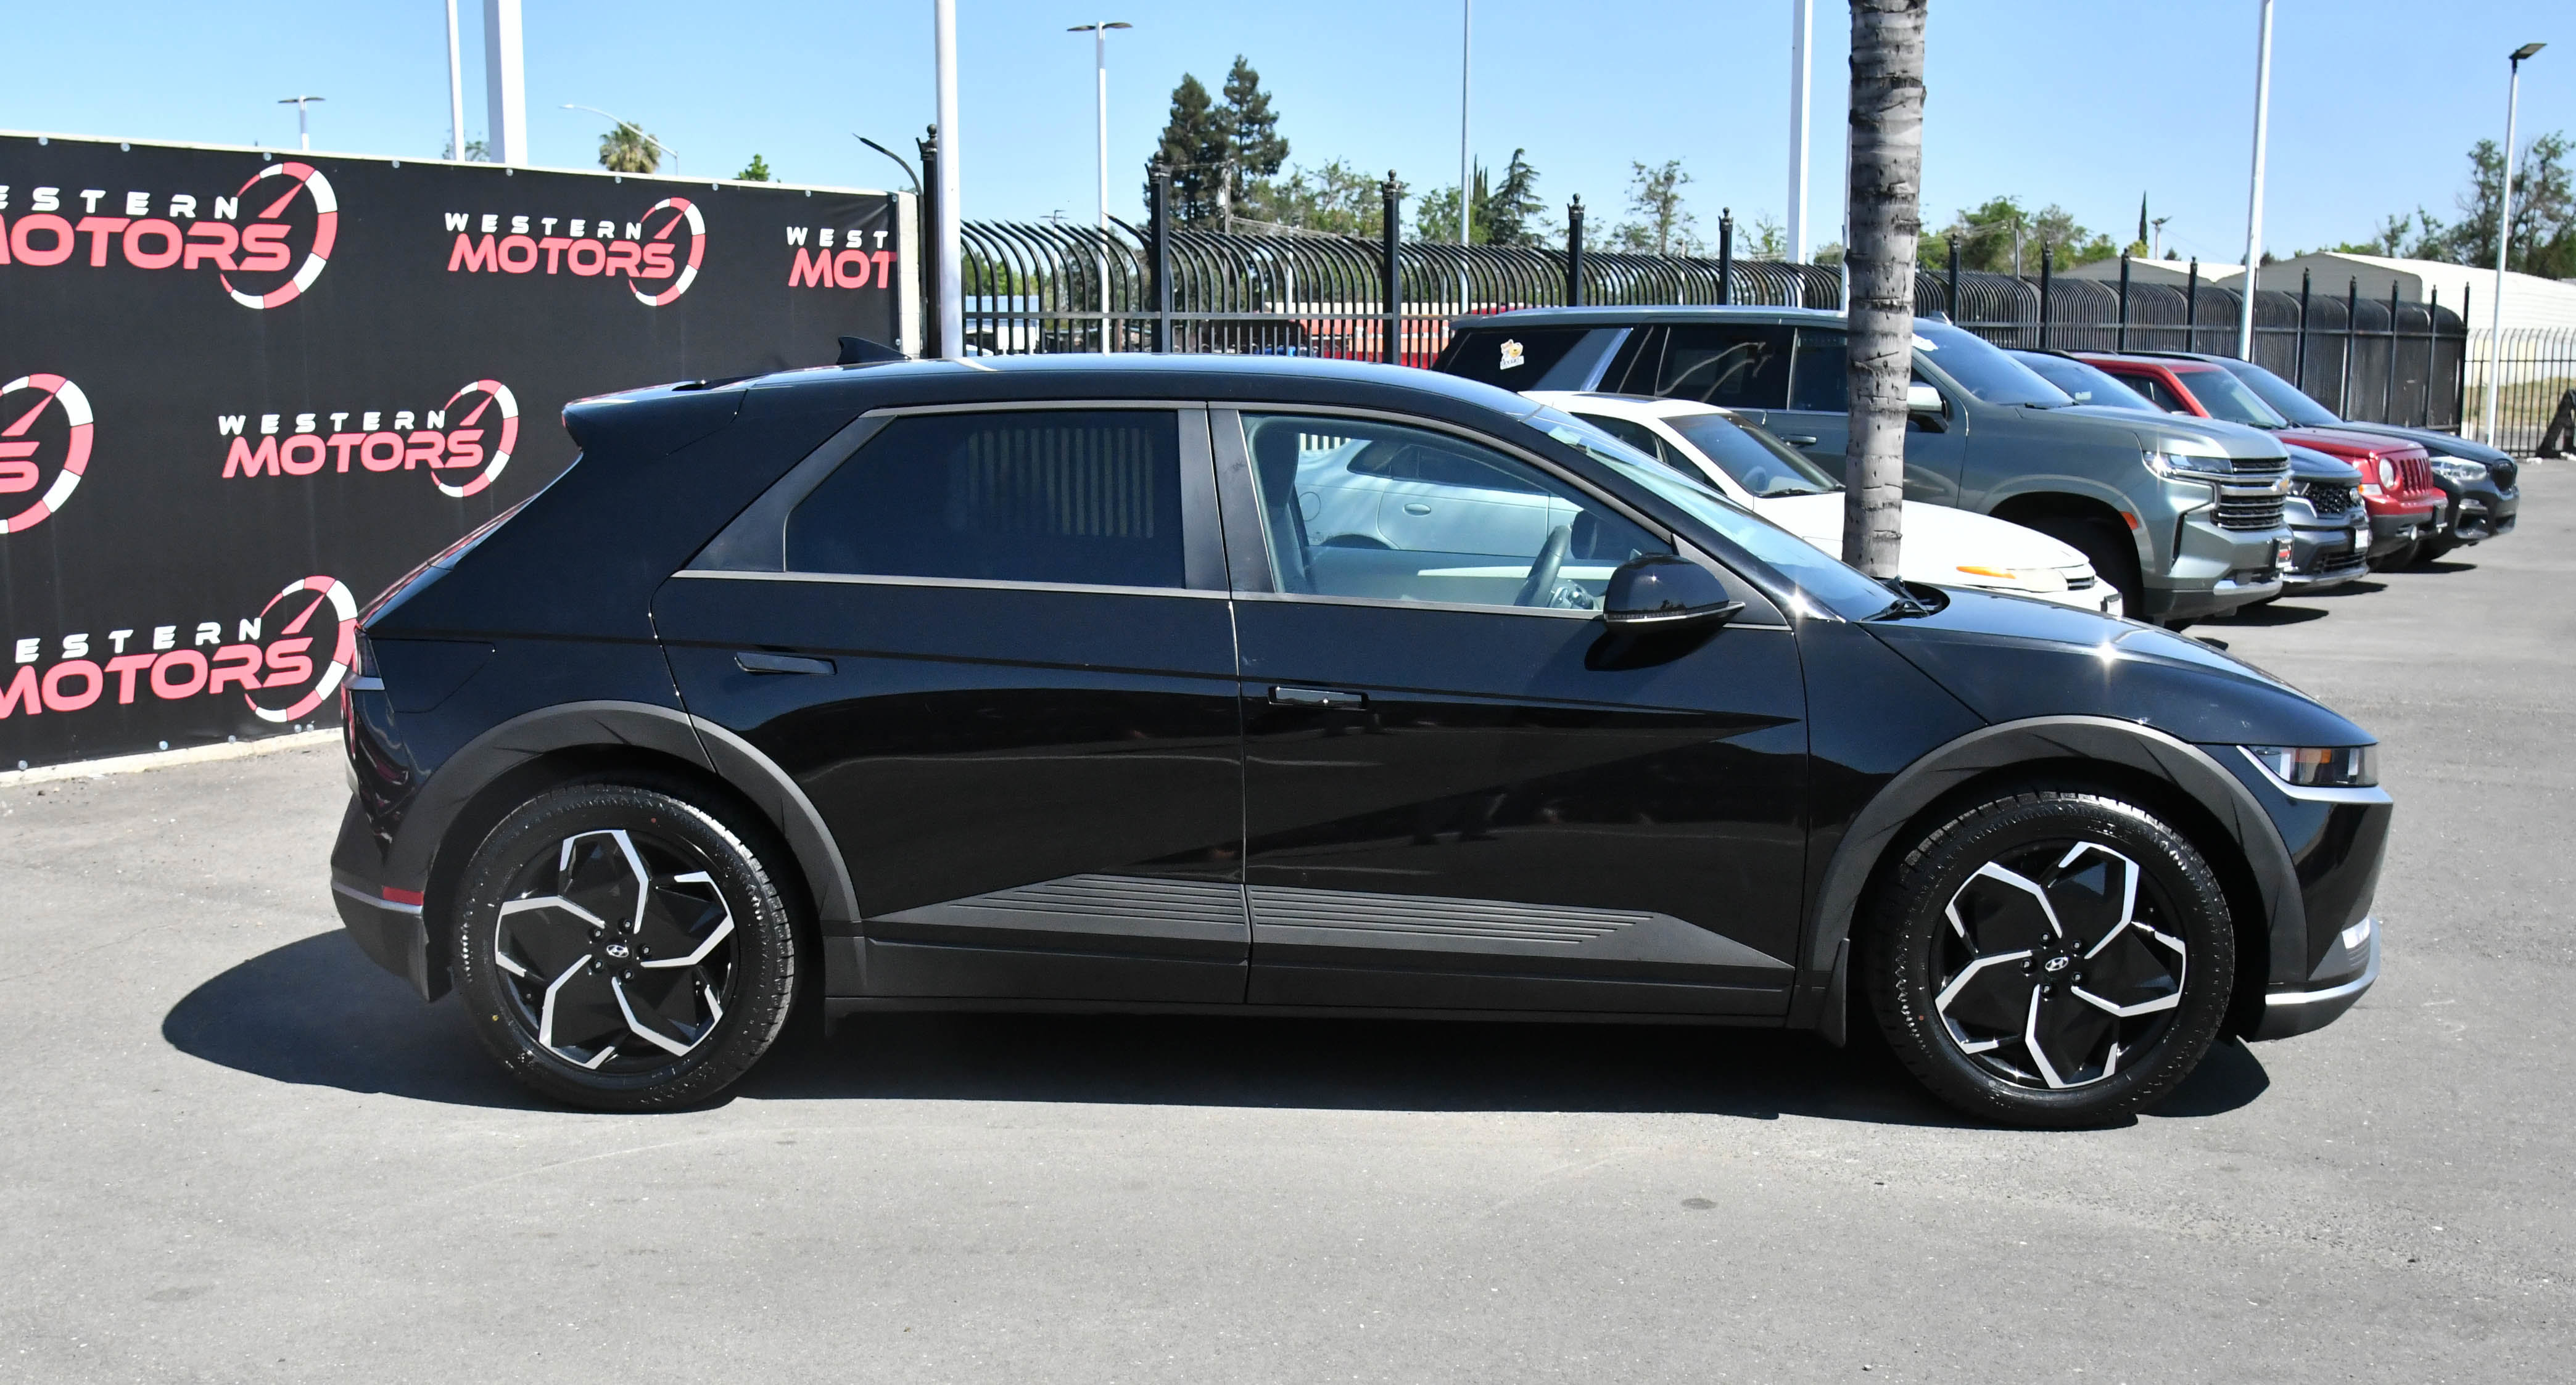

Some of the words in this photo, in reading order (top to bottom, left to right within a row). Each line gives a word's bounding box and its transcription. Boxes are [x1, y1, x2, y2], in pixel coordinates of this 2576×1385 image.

[0, 212, 292, 273] OTORS
[445, 212, 642, 240] WESTERN
[786, 226, 889, 249] WEST
[447, 232, 676, 279] MOTORS
[787, 247, 898, 289] MOT
[218, 410, 446, 437] WESTERN
[221, 429, 484, 479] MOTORS
[15, 617, 262, 664] ESTERN
